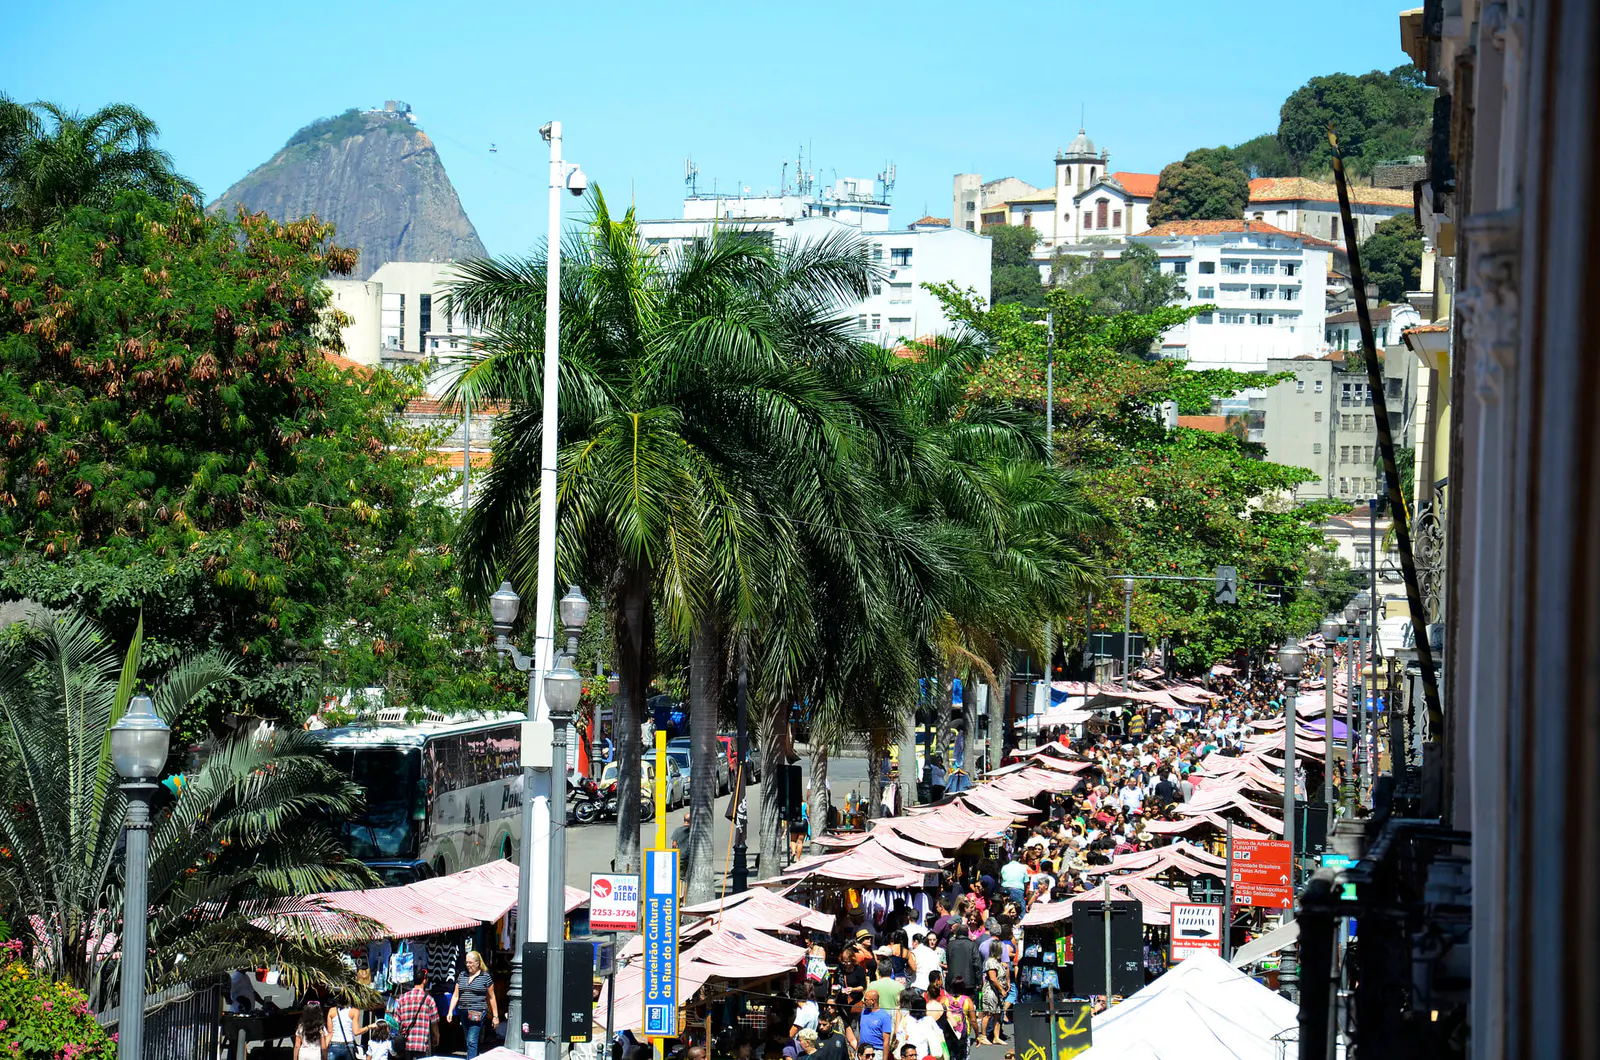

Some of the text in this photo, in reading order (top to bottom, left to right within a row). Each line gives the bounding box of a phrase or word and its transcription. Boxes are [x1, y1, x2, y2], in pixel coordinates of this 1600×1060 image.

[613, 891, 637, 901] DIEGO
[1256, 885, 1288, 893] Metropolitana
[592, 908, 636, 917] 2253-3756
[1179, 908, 1214, 916] HOTEL
[662, 898, 673, 944] Lavradio
[648, 898, 659, 1000] Quarteirão Cultural
[662, 946, 672, 960] do
[662, 962, 672, 982] Rua
[662, 984, 672, 998] da
